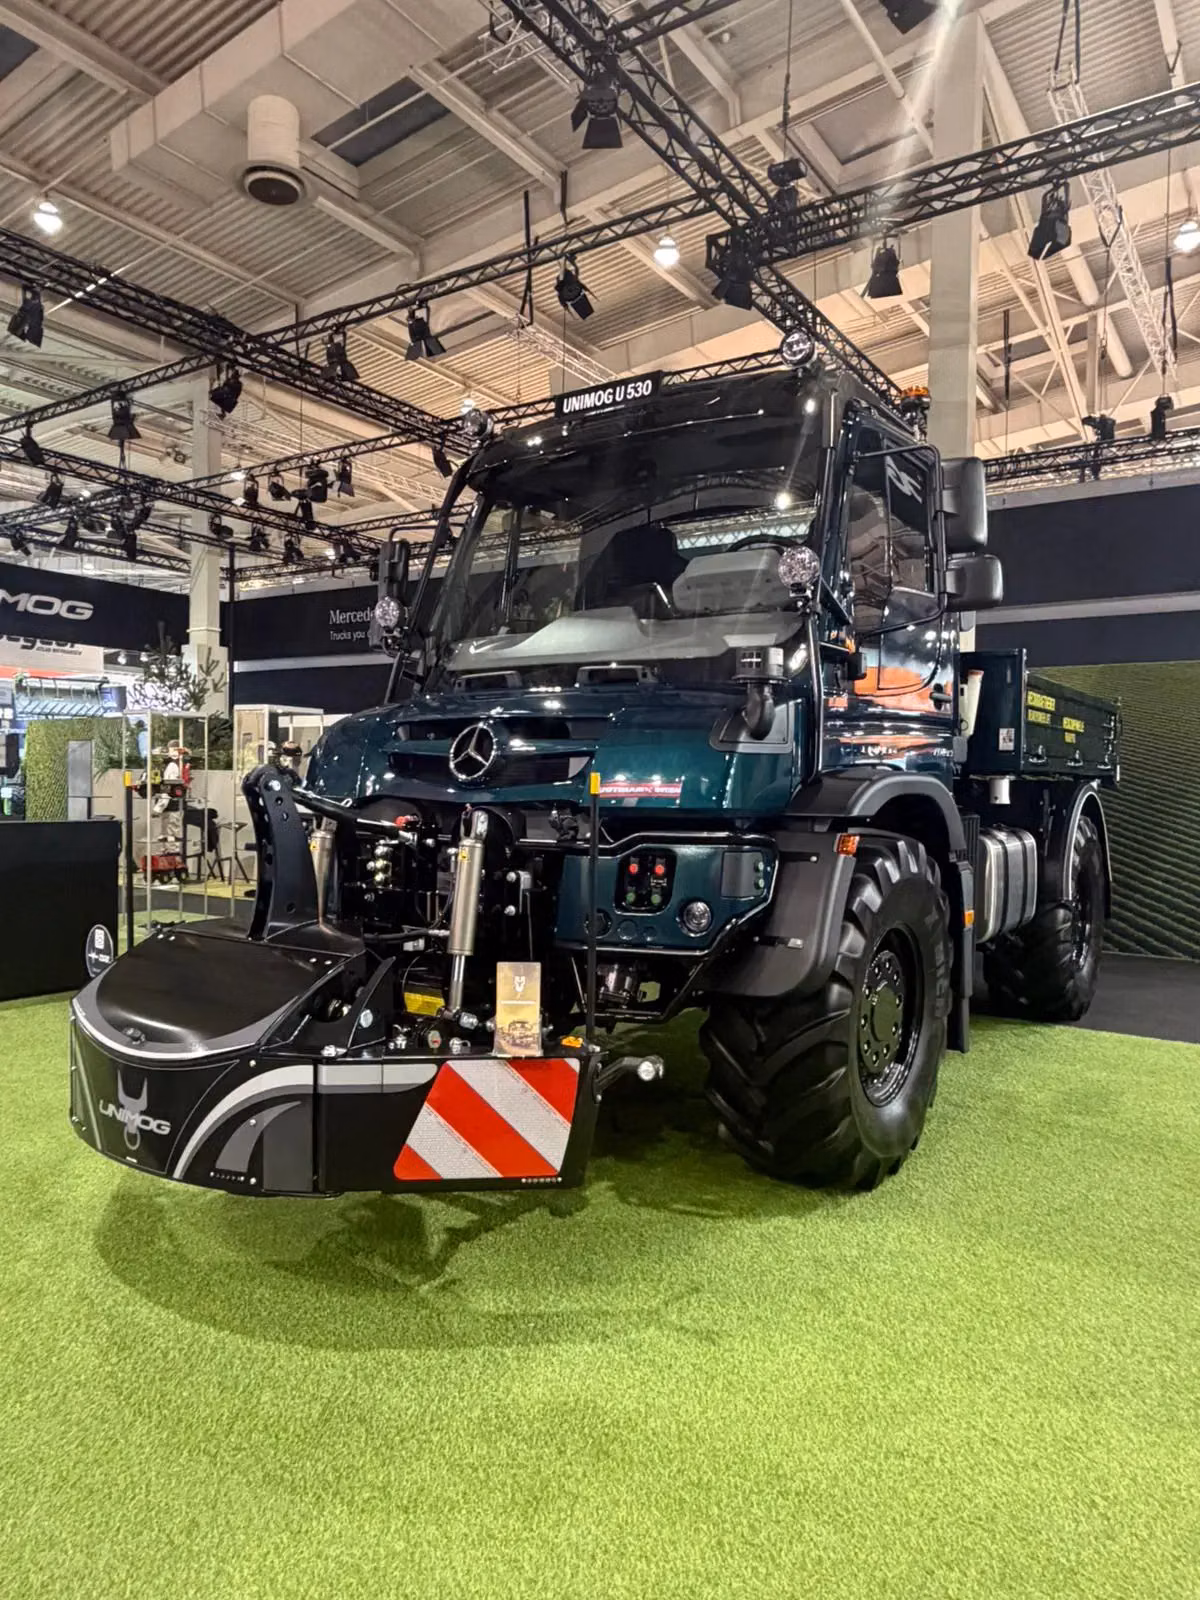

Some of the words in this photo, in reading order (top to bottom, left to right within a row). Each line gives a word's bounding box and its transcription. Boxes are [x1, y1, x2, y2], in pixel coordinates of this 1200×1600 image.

[563, 388, 614, 413] UNIMOG
[615, 385, 625, 402] U
[626, 379, 653, 400] 530
[330, 630, 352, 641] Trucks
[352, 631, 366, 643] you
[99, 1099, 171, 1135] UNIMOG
